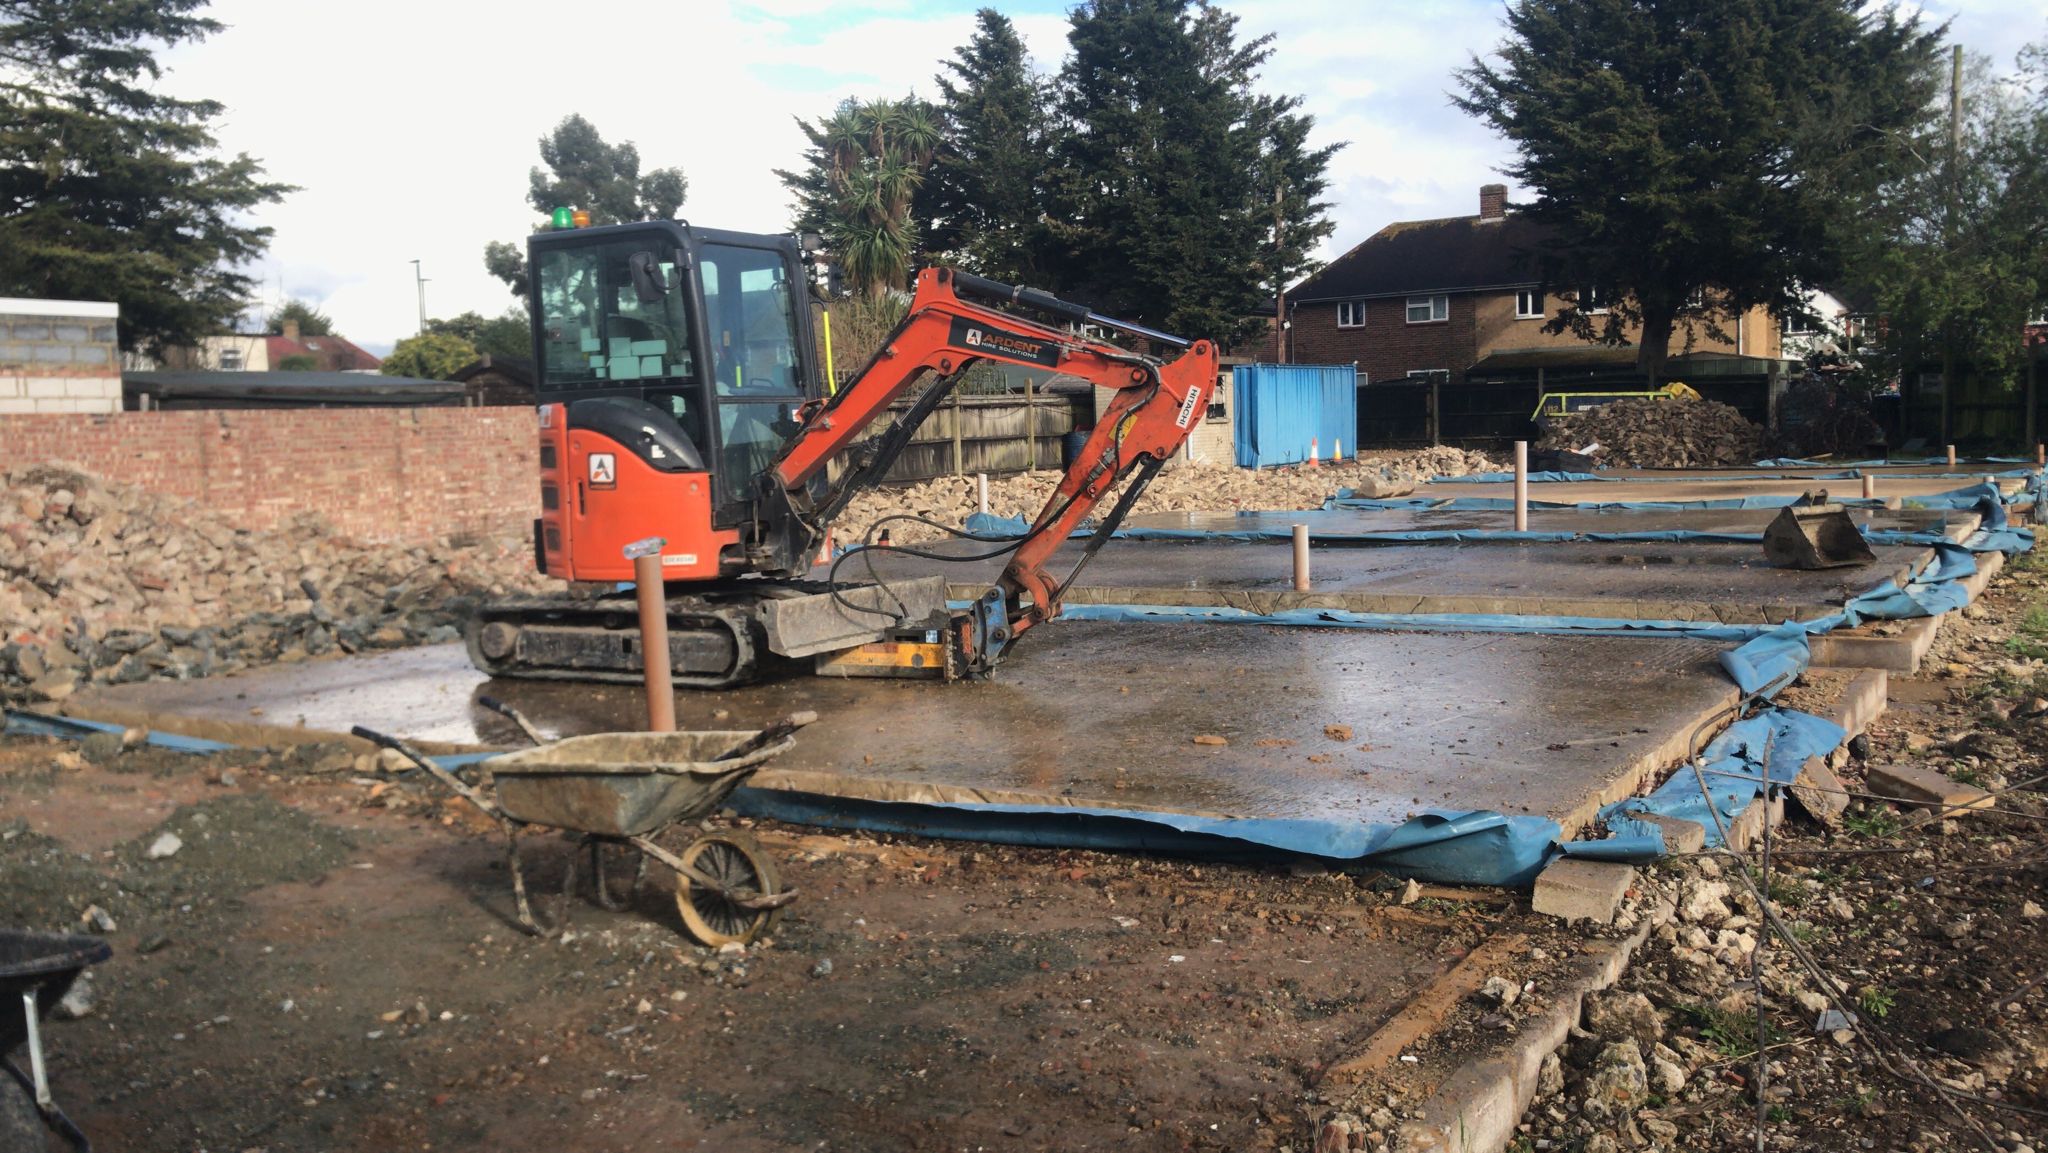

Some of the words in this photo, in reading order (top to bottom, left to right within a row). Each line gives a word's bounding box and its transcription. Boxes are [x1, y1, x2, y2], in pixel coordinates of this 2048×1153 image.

[983, 334, 1042, 353] ARDENT
[998, 346, 1038, 359] SOLUTIONS
[1178, 388, 1198, 425] HITACHI
